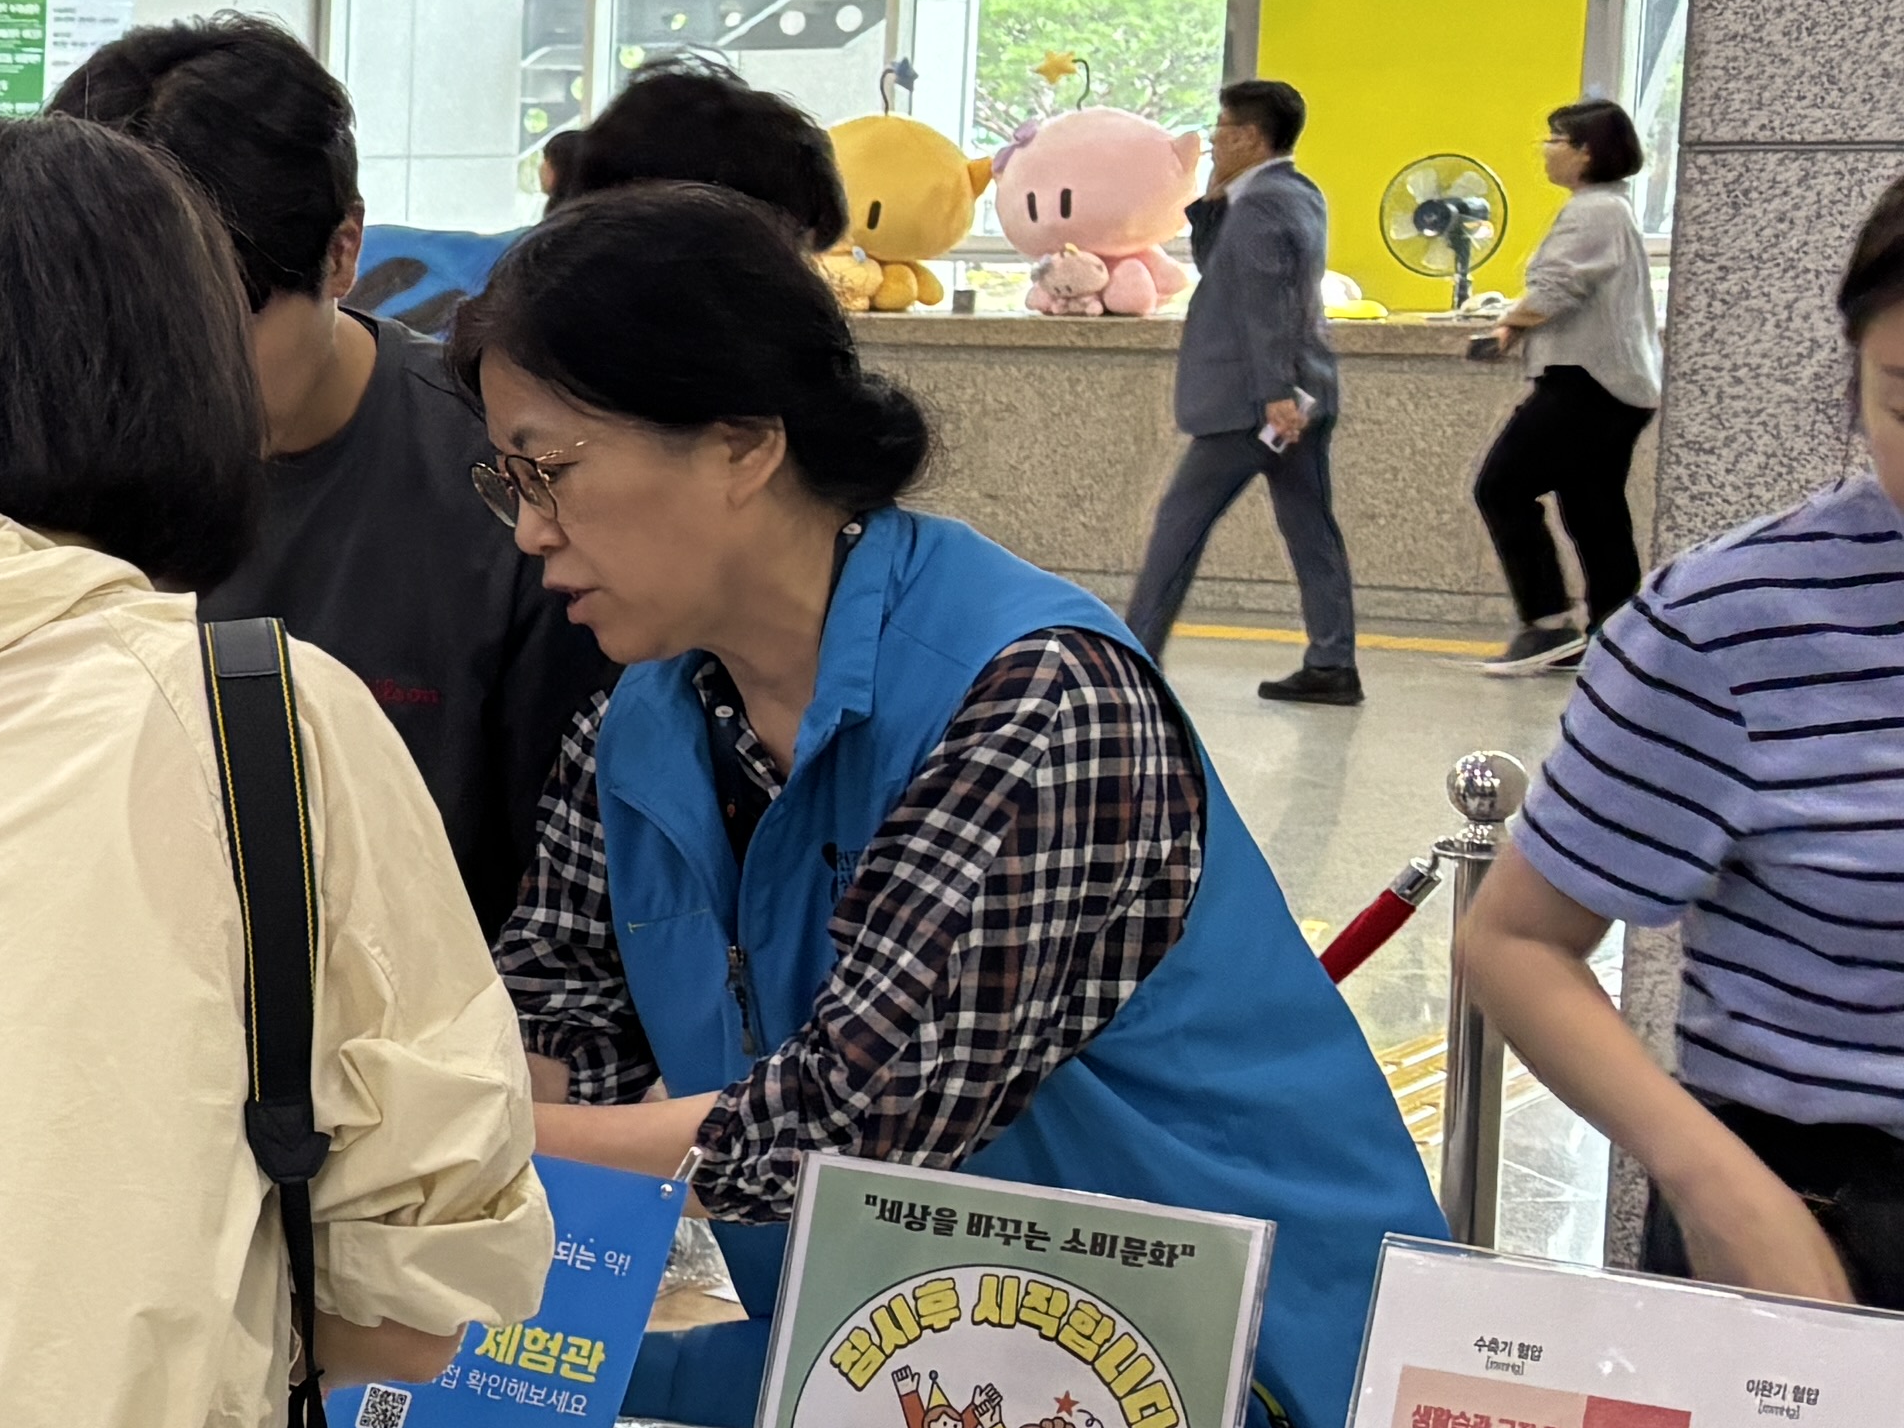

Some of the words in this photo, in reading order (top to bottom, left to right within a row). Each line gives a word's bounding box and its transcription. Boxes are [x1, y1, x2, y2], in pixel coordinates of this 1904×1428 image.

[965, 1211, 1052, 1254] 바꾸는
[603, 1250, 631, 1277] 약!
[474, 1322, 606, 1383] 체험관
[829, 1276, 962, 1392] 잠시후
[465, 1369, 588, 1417] 확인해보세요
